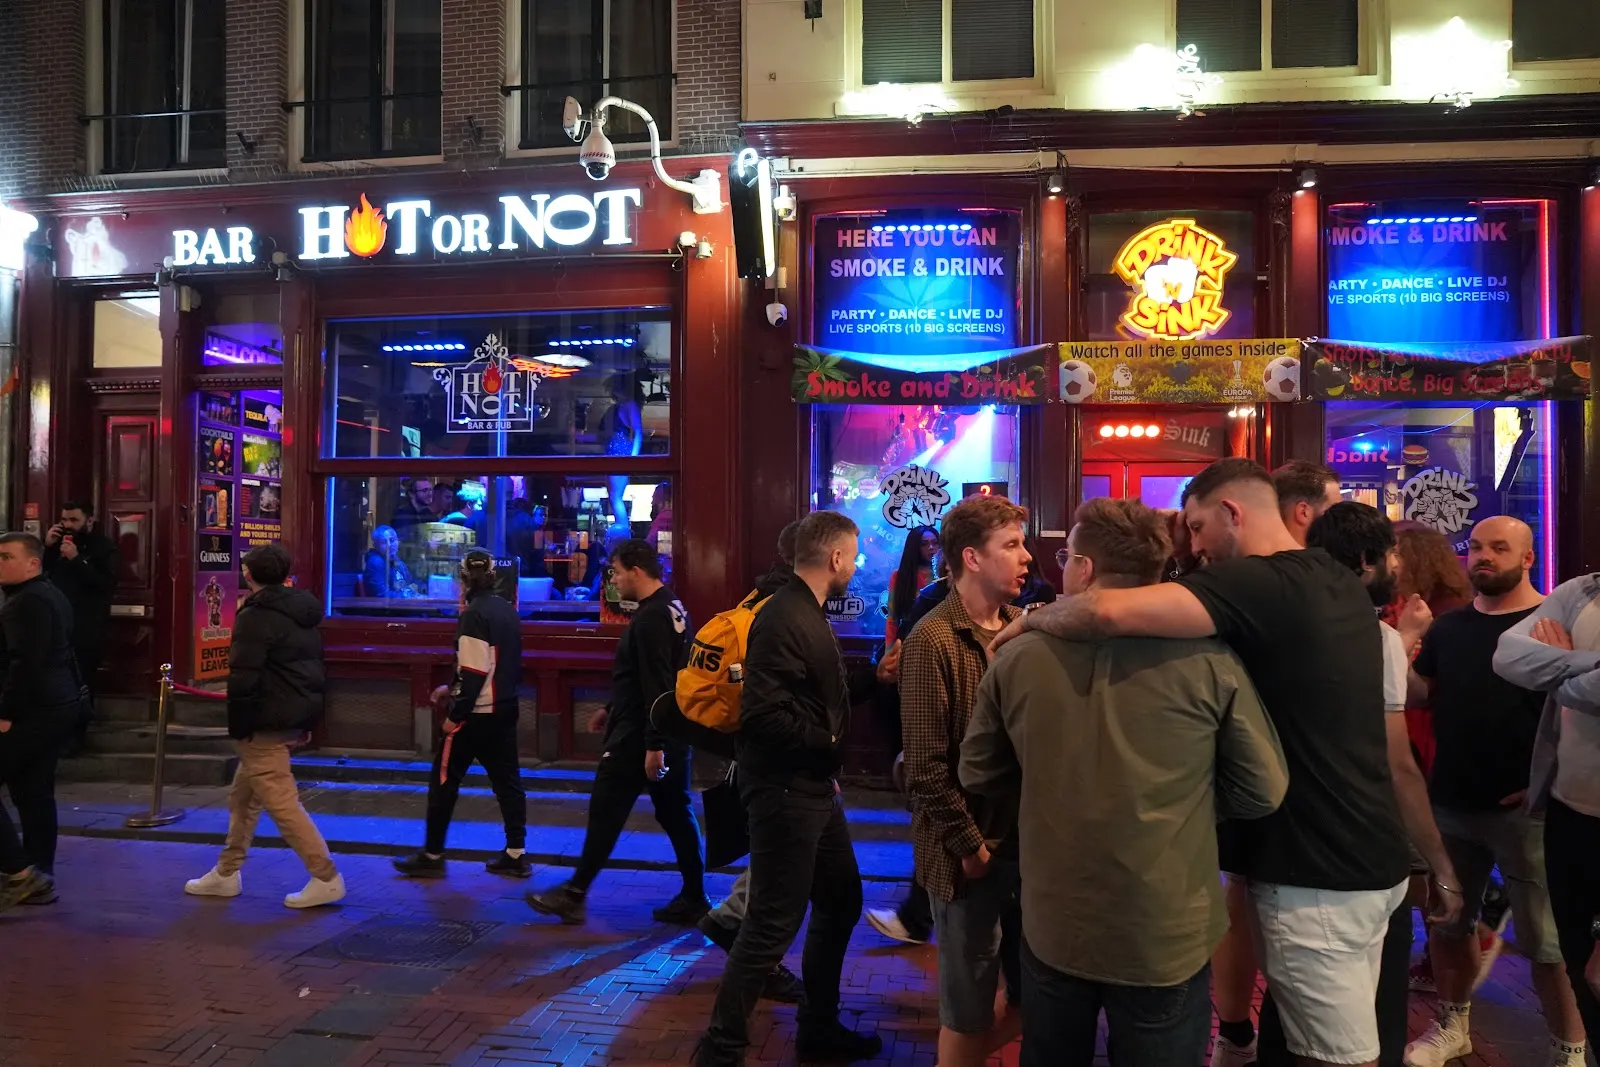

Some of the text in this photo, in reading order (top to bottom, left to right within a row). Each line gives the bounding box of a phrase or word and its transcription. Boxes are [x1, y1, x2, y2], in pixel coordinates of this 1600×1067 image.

[432, 213, 491, 253] OR
[498, 188, 641, 250] NOT
[837, 227, 996, 248] HERE YOU CAN
[1408, 224, 1424, 243] &
[1432, 222, 1507, 242] DRINK
[173, 226, 256, 266] BAR
[830, 257, 1004, 277] SMOKE & DRINK
[1381, 277, 1434, 289] DANCE
[1447, 276, 1482, 288] LIVE
[1488, 276, 1507, 287] DJ
[1347, 293, 1397, 304] SPORTS
[1400, 292, 1417, 305] (10
[1420, 292, 1442, 302] BIG
[1445, 290, 1509, 302] SCREENS)
[831, 308, 1003, 320] PARTY DANCE LIVE DJ
[829, 322, 1005, 334] LIVE SPORTS (10 BIG SCREENS)
[1070, 342, 1287, 360] Watch all the games inside
[805, 371, 891, 398] Smoke
[901, 371, 950, 398] and
[960, 371, 1037, 398] Drink
[1423, 373, 1454, 396] Big
[460, 393, 521, 415] NOT
[200, 427, 233, 440] COCKTAILS
[467, 421, 512, 430] BAR & PUB
[1163, 417, 1211, 447] Sink
[200, 551, 230, 562] GUINNESS
[202, 646, 230, 659] ENTER
[201, 658, 229, 672] LEAVE
